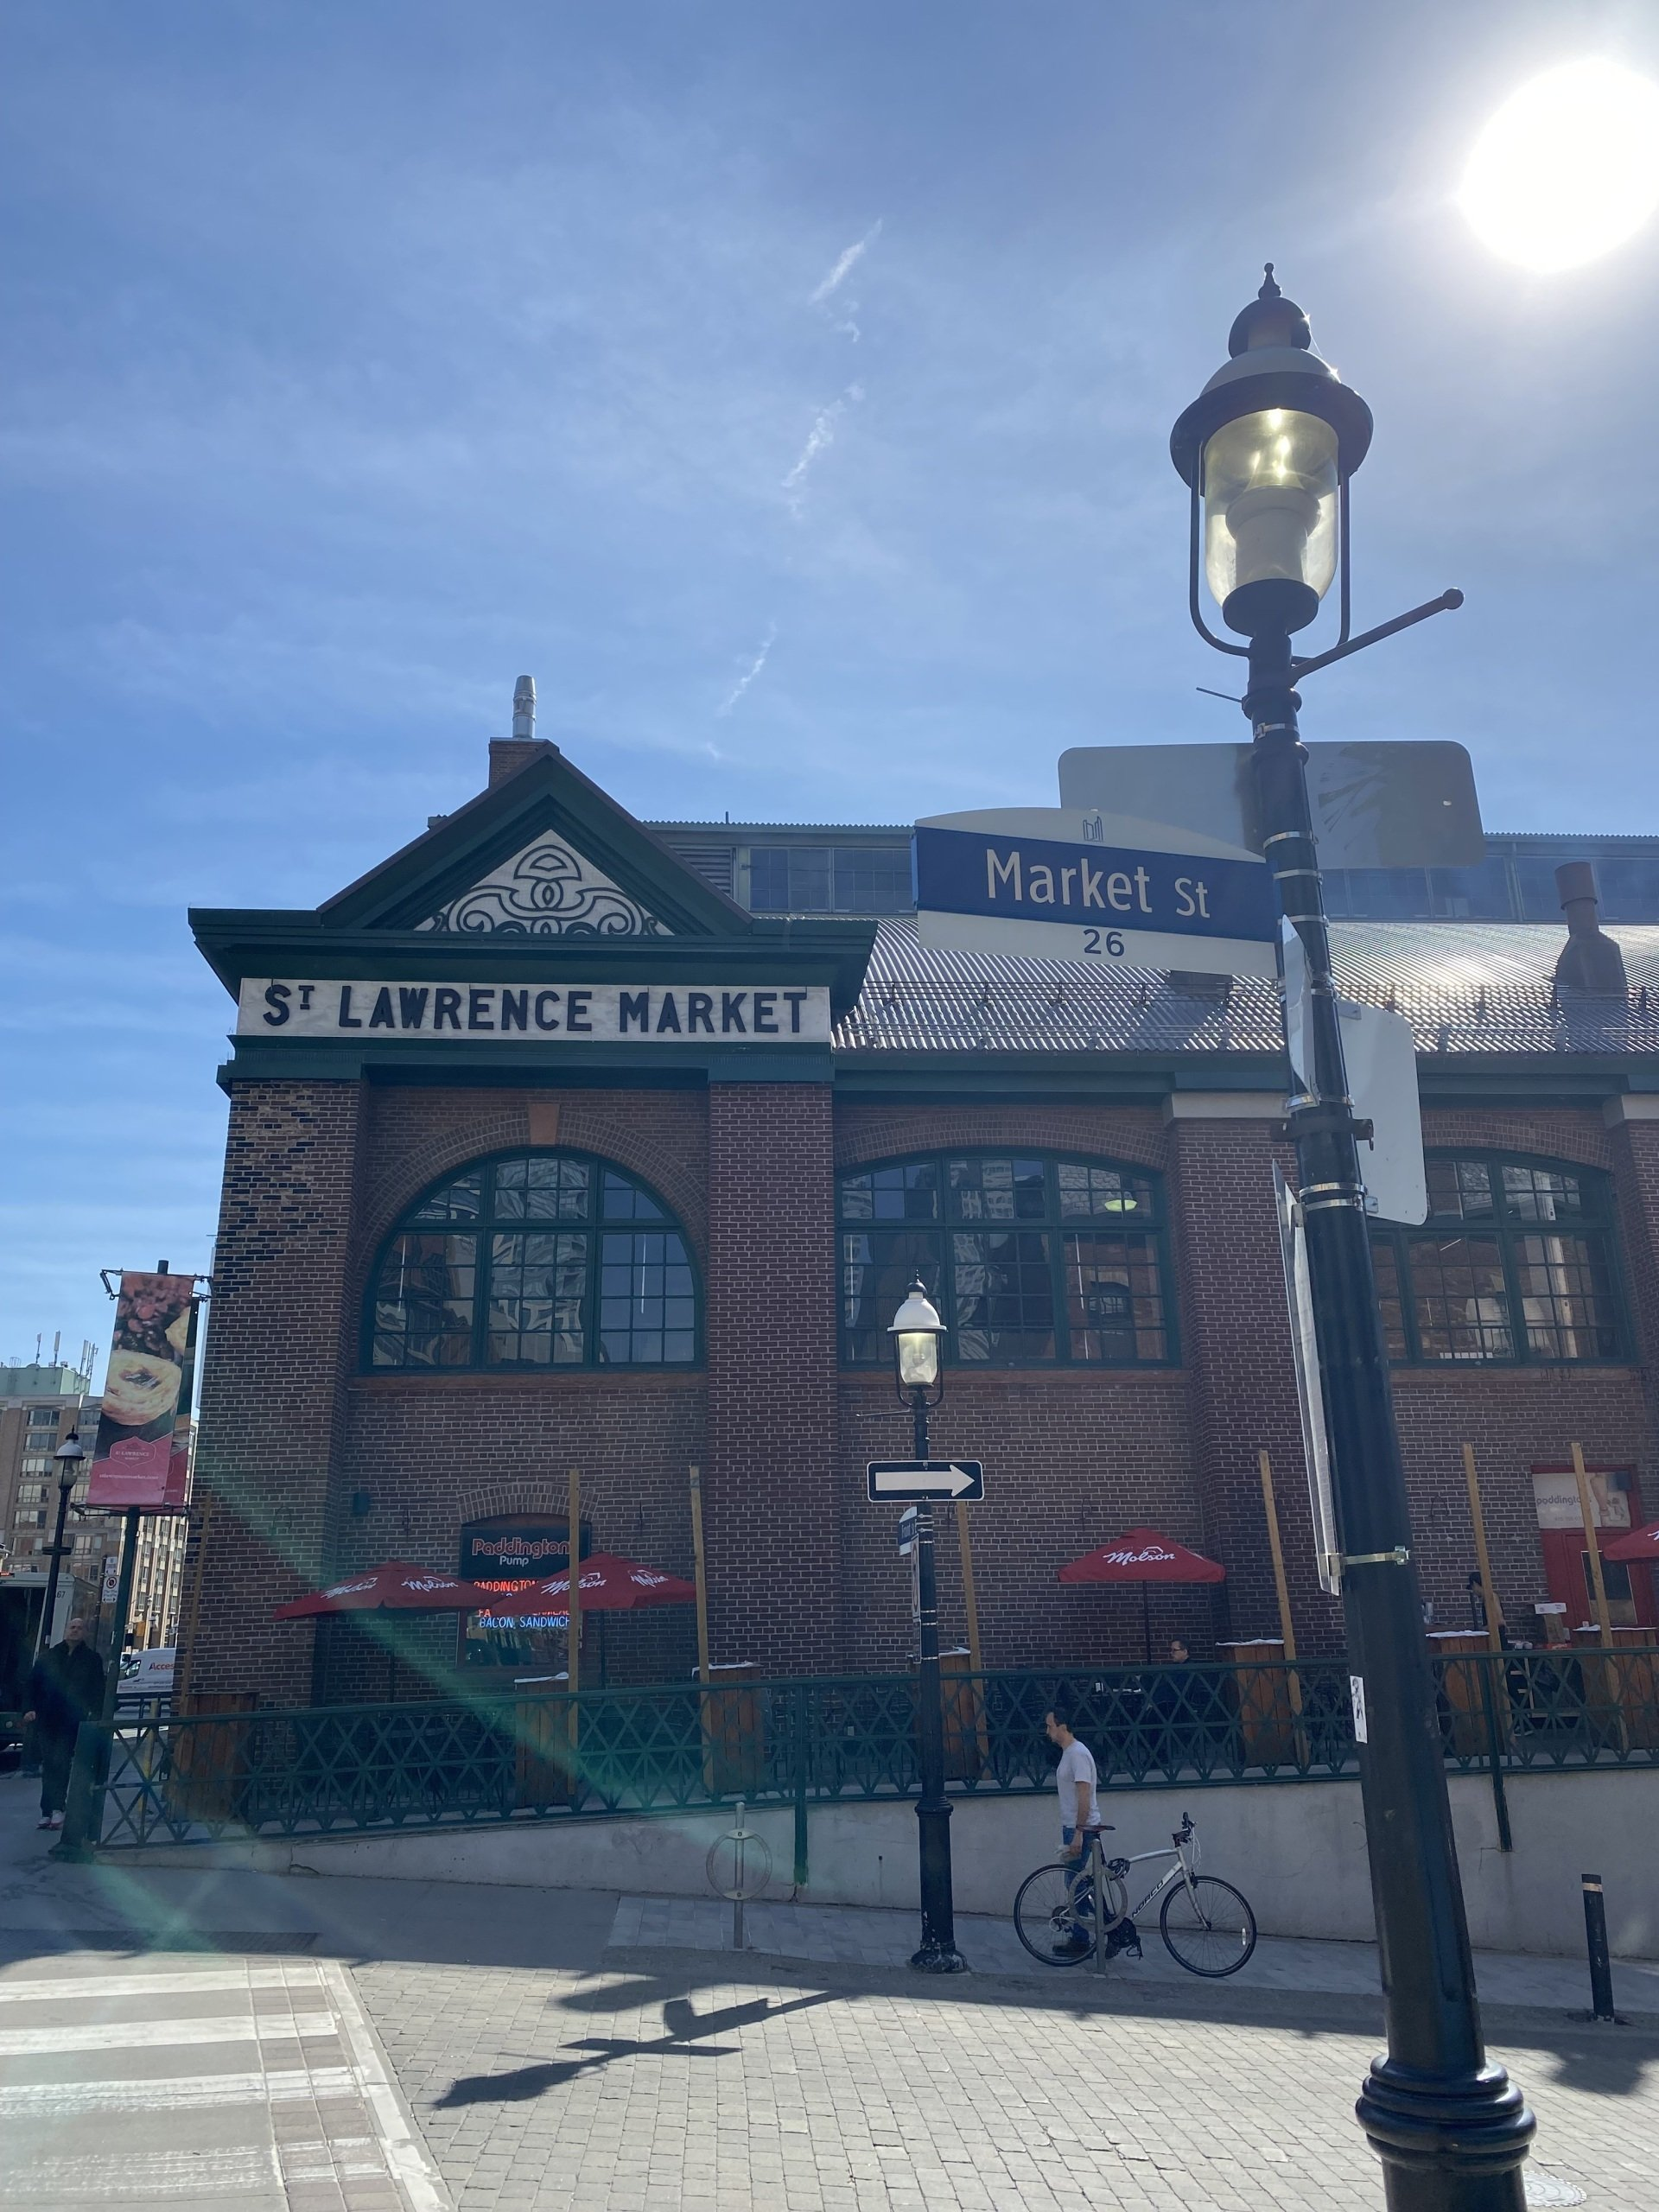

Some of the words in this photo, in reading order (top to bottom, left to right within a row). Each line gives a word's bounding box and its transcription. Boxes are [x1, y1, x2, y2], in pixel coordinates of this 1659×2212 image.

[986, 849, 1153, 913] Market
[1174, 877, 1211, 918] St
[1083, 929, 1125, 957] 26
[339, 985, 592, 1032] LAWRENCE
[619, 991, 808, 1033] MARKET
[499, 1555, 530, 1567] Pump
[1103, 1551, 1176, 1566] Molson
[401, 1580, 459, 1592] Molson
[55, 1590, 66, 1599] 67
[479, 1617, 513, 1629] BACON
[149, 1662, 175, 1671] Acces
[1131, 1879, 1164, 1918] NORCO
